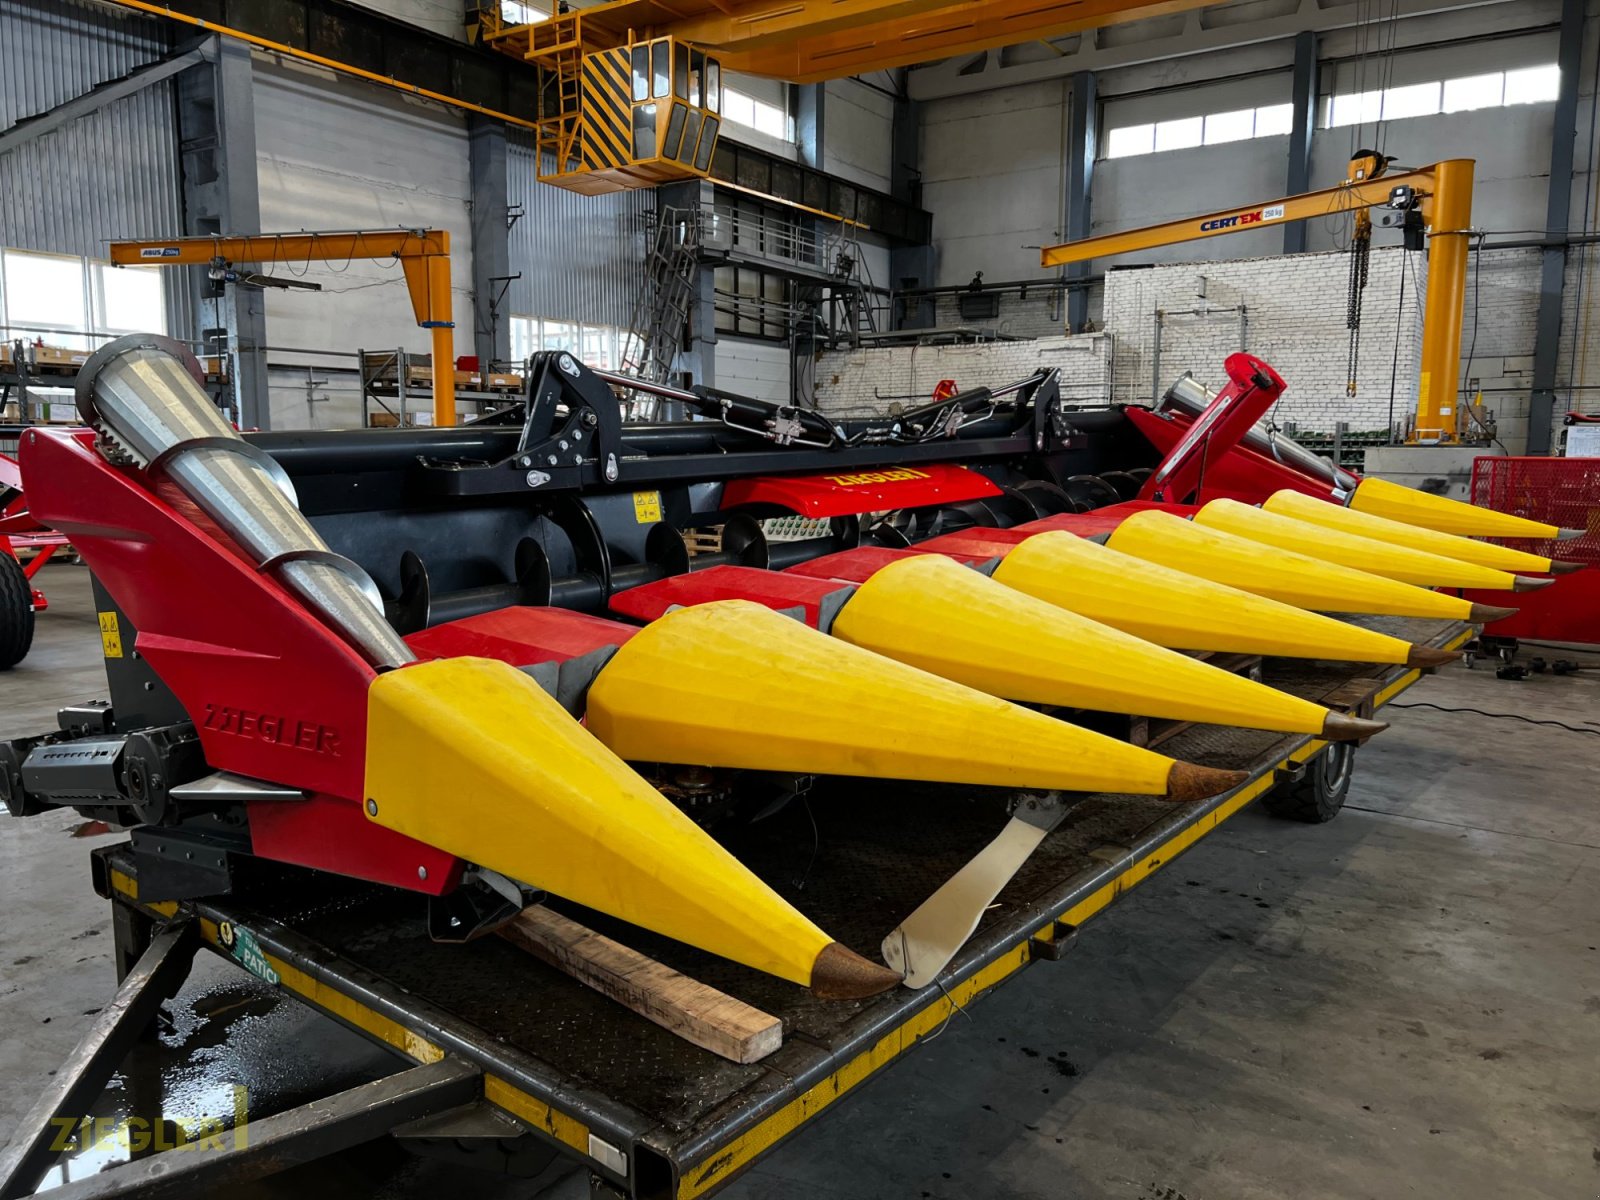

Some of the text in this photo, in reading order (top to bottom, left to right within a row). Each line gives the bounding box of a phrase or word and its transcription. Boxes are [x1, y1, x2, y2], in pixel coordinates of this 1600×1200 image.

[1200, 211, 1262, 232] CERTEX
[823, 468, 924, 486] ZIEGLER
[203, 703, 342, 757] ZIEGLER
